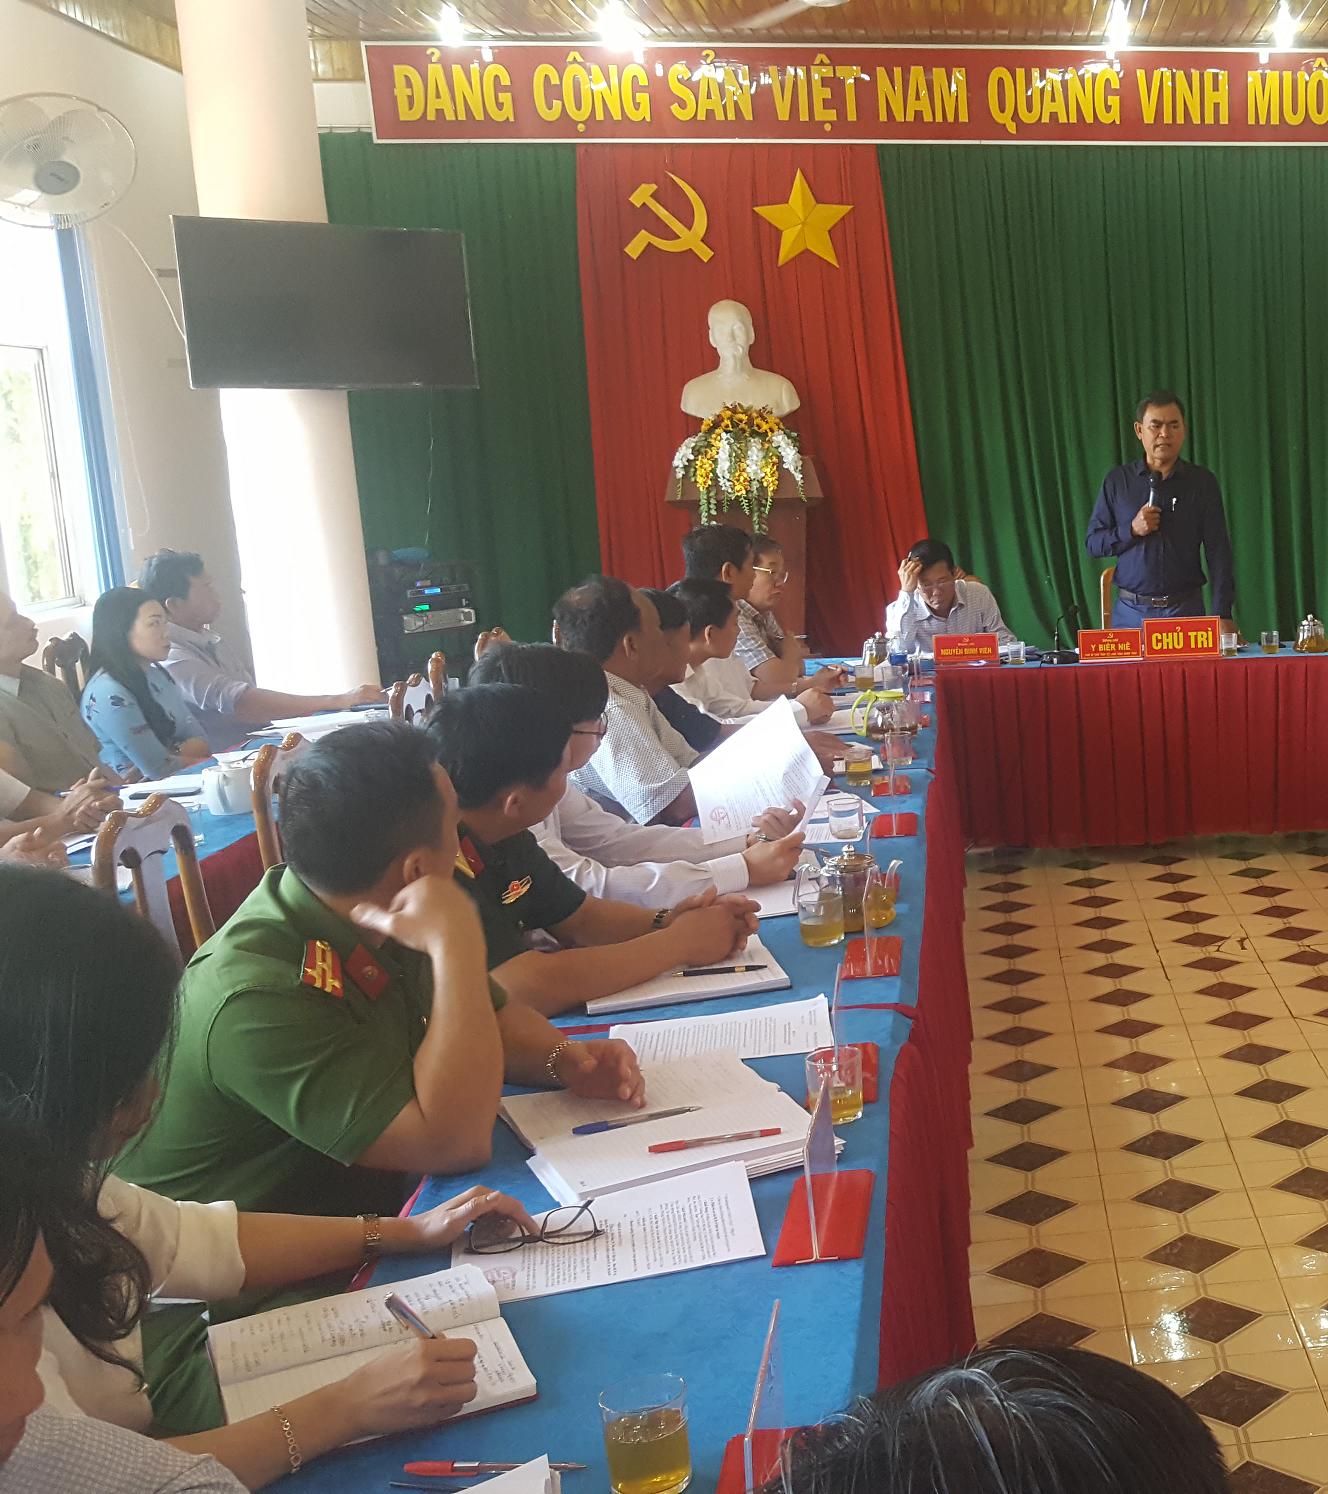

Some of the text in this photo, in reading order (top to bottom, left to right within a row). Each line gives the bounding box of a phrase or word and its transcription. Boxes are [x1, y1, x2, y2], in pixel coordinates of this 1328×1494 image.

[393, 47, 514, 122] ĐẢNG
[533, 51, 650, 132] CỘNG
[668, 50, 754, 122] SẢN
[770, 53, 862, 132] VIỆT
[876, 66, 968, 123] NAM
[987, 66, 1121, 134] QUANG
[1137, 69, 1229, 125] VINH
[1151, 626, 1213, 650] CHỦ TRÌ
